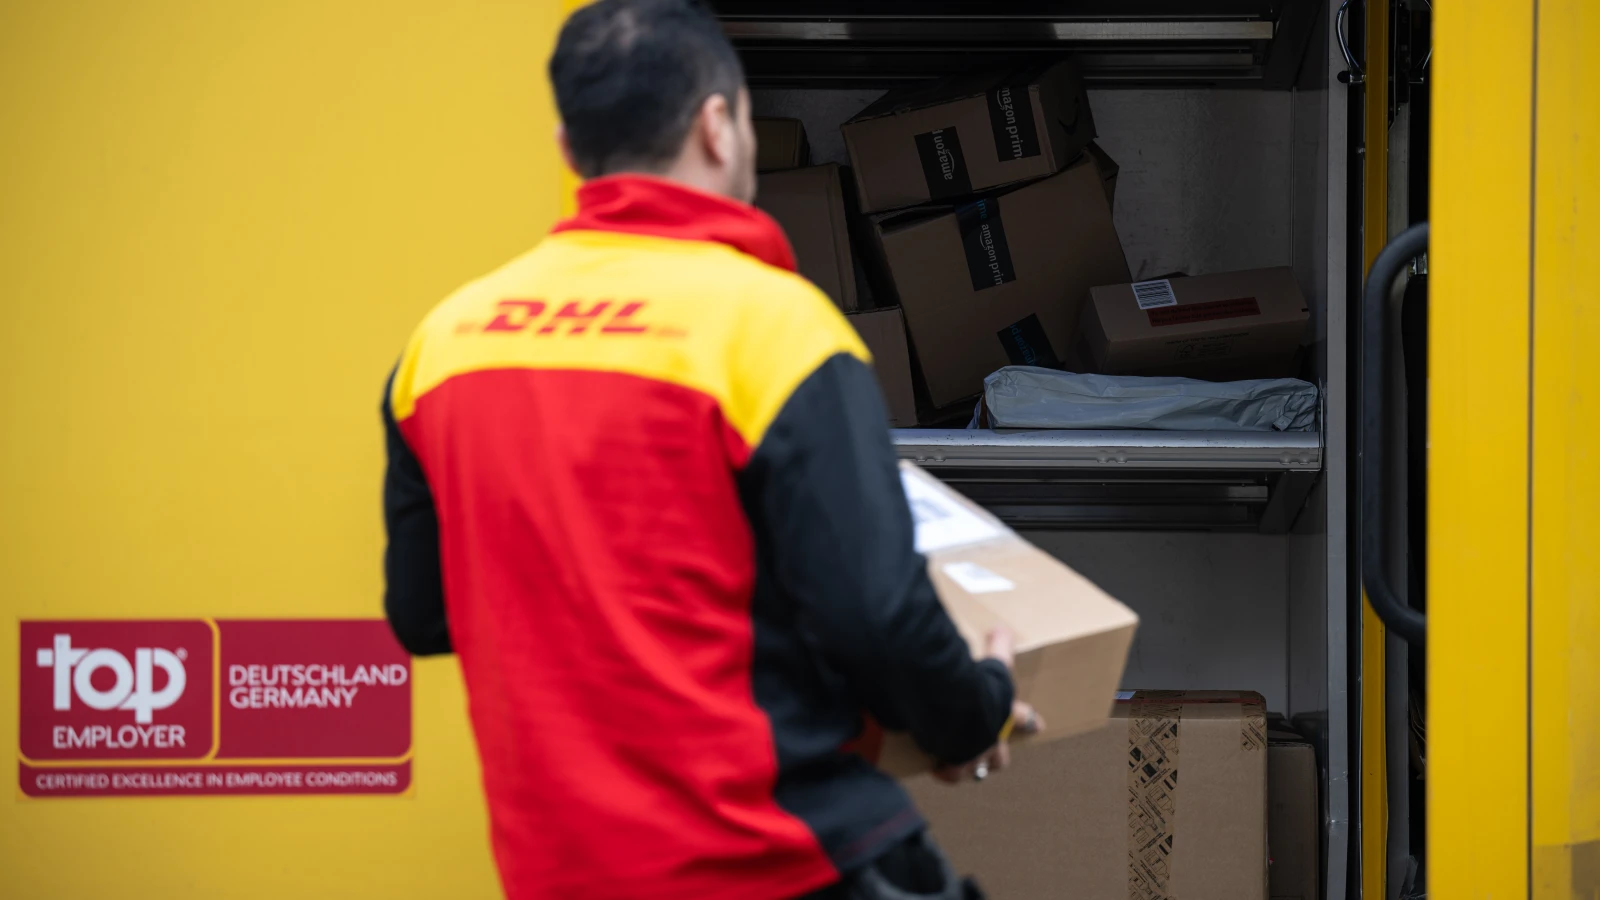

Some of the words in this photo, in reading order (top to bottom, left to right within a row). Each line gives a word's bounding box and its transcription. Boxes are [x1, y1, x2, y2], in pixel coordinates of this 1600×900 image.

[1000, 87, 1016, 126] mazon
[934, 136, 953, 180] amazon
[1005, 126, 1023, 159] prim
[981, 224, 997, 262] amazon
[482, 299, 646, 335] DHL
[37, 633, 187, 724] top
[229, 664, 408, 687] DEUTSCHLAND
[229, 686, 358, 709] GERMANY
[53, 725, 186, 749] EMPLOYER
[36, 773, 109, 790] CERTIFIED
[113, 772, 203, 789] EXCELLENCE
[206, 772, 223, 788] IN
[225, 772, 303, 788] EMPLOYEE
[305, 771, 398, 788] CONDITIONS
